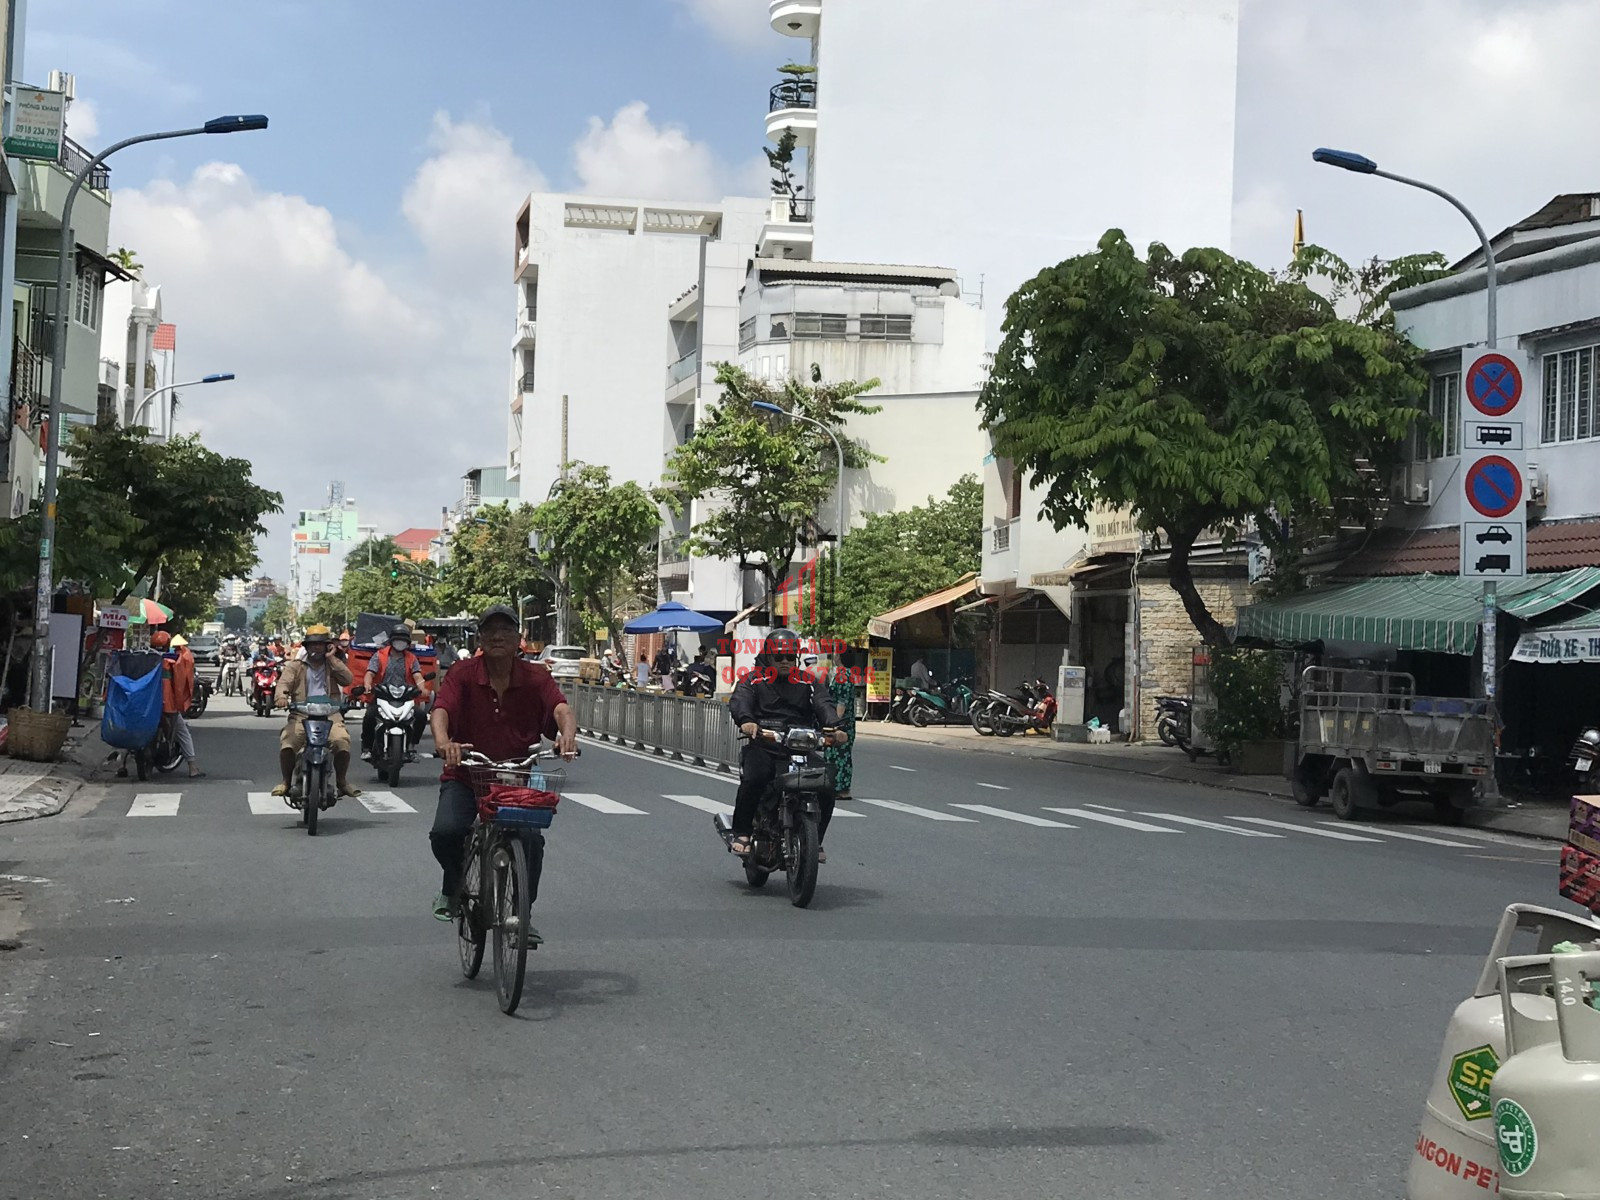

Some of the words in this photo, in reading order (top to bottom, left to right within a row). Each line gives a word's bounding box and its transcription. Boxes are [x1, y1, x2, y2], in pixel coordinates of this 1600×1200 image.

[33, 126, 45, 135] 234
[1564, 638, 1579, 658] XE
[1558, 976, 1577, 1006] 14.0
